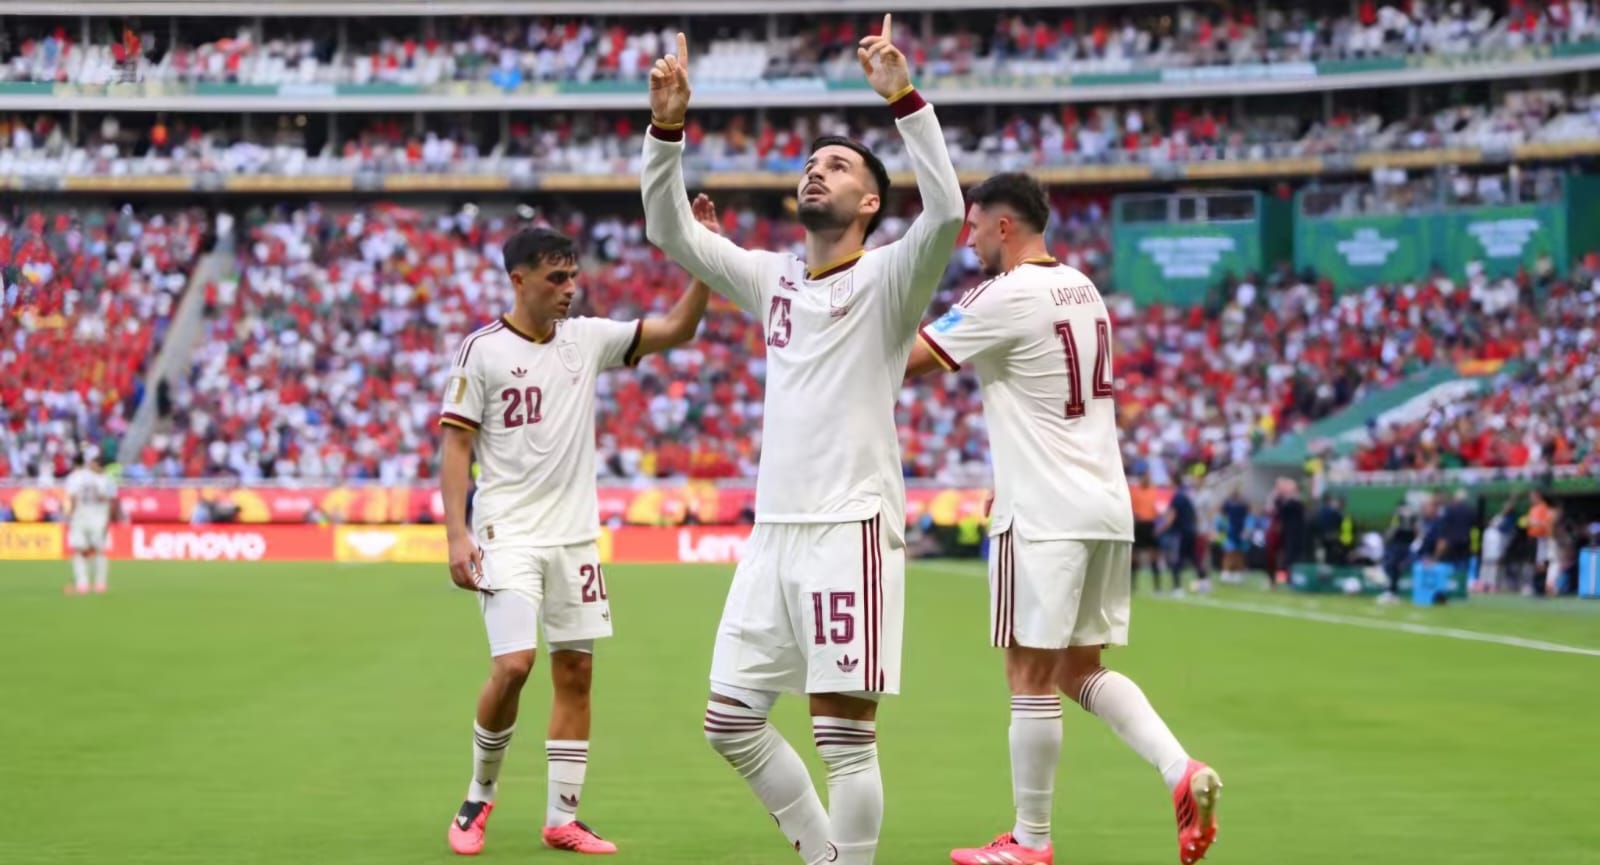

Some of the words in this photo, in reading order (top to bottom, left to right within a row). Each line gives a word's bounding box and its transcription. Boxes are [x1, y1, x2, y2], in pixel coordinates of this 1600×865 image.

[1053, 318, 1112, 419] 14
[501, 386, 543, 428] 20
[132, 525, 266, 560] Lenovo
[679, 528, 749, 562] Len
[812, 591, 856, 645] 15
